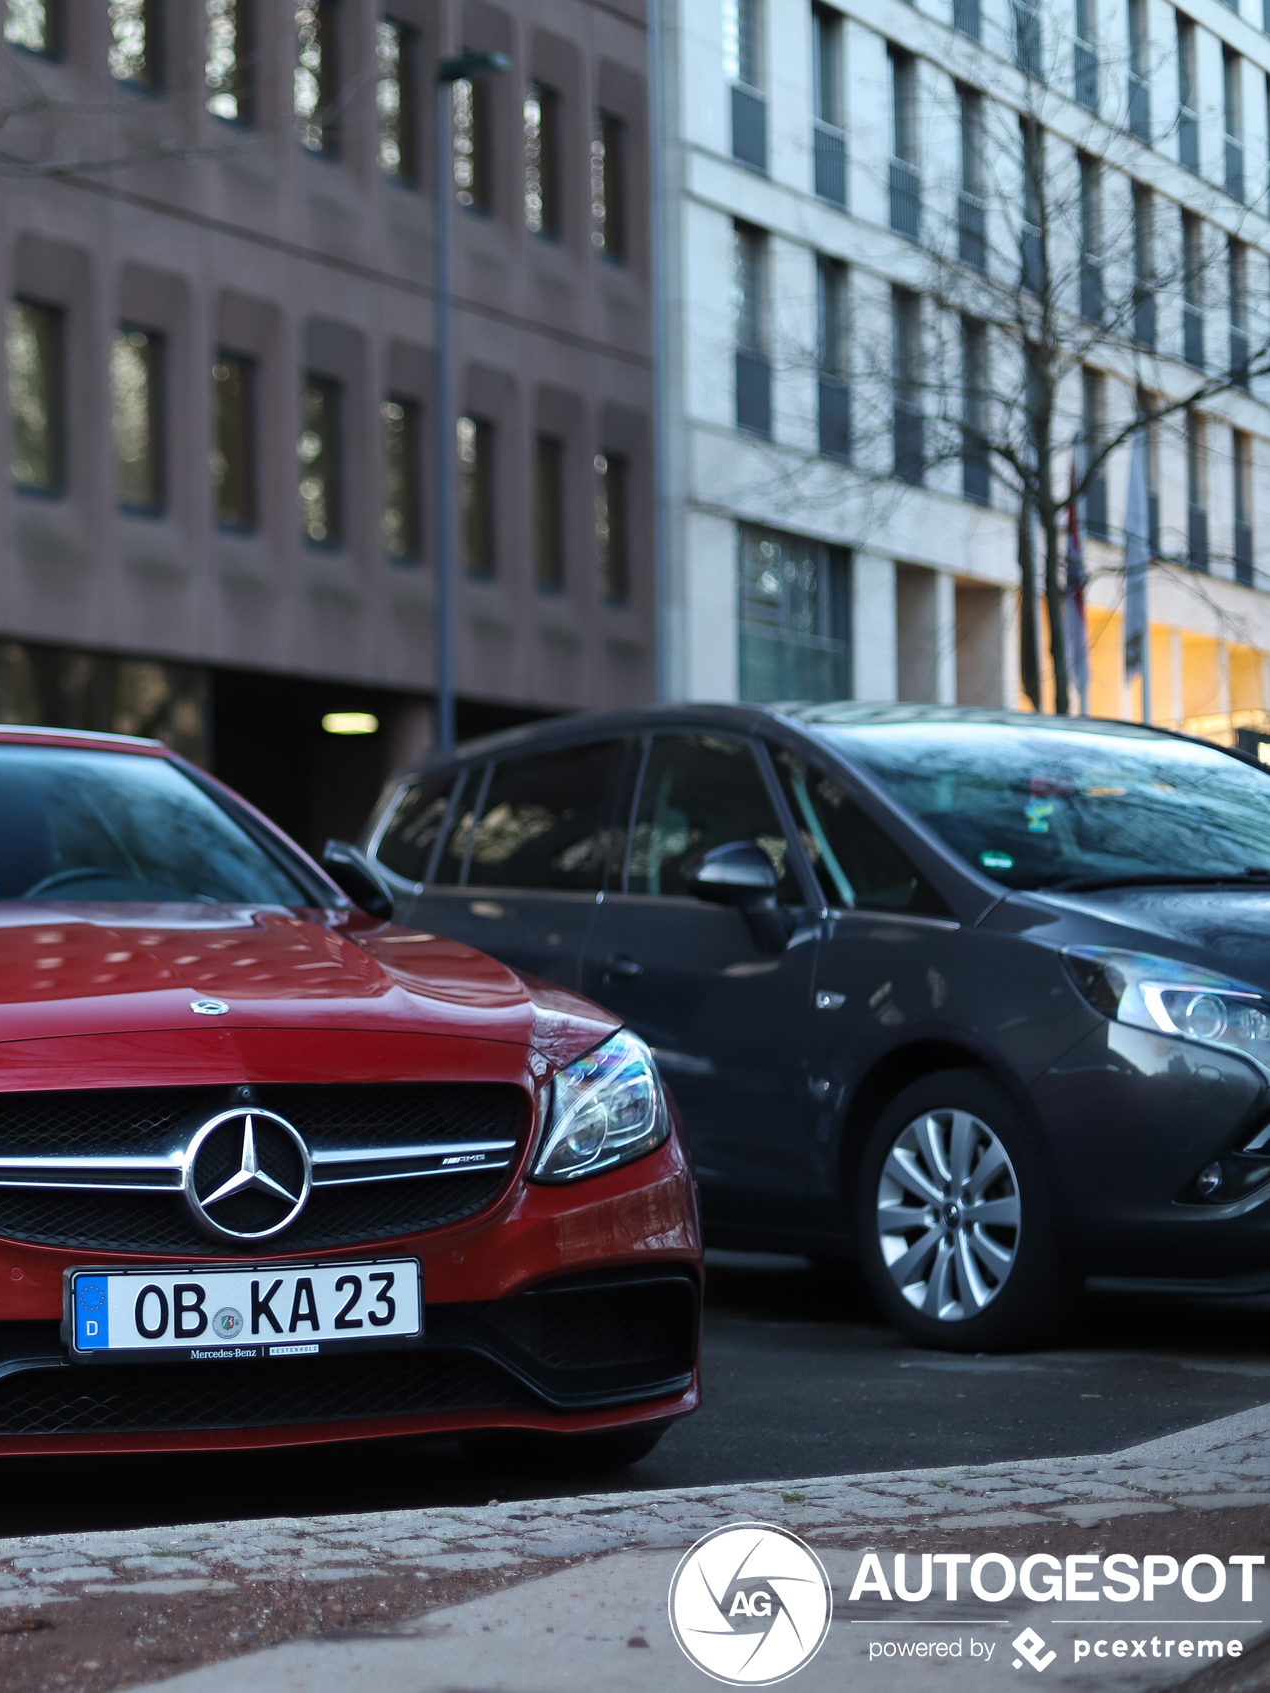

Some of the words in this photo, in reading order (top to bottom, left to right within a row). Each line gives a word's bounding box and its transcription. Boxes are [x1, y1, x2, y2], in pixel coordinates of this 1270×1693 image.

[134, 1282, 208, 1339] OB
[250, 1277, 320, 1334] KA
[334, 1272, 396, 1330] 23
[86, 1320, 99, 1336] D
[190, 1348, 257, 1360] Mercedes-Benz
[271, 1346, 318, 1354] KESTENHOLZ
